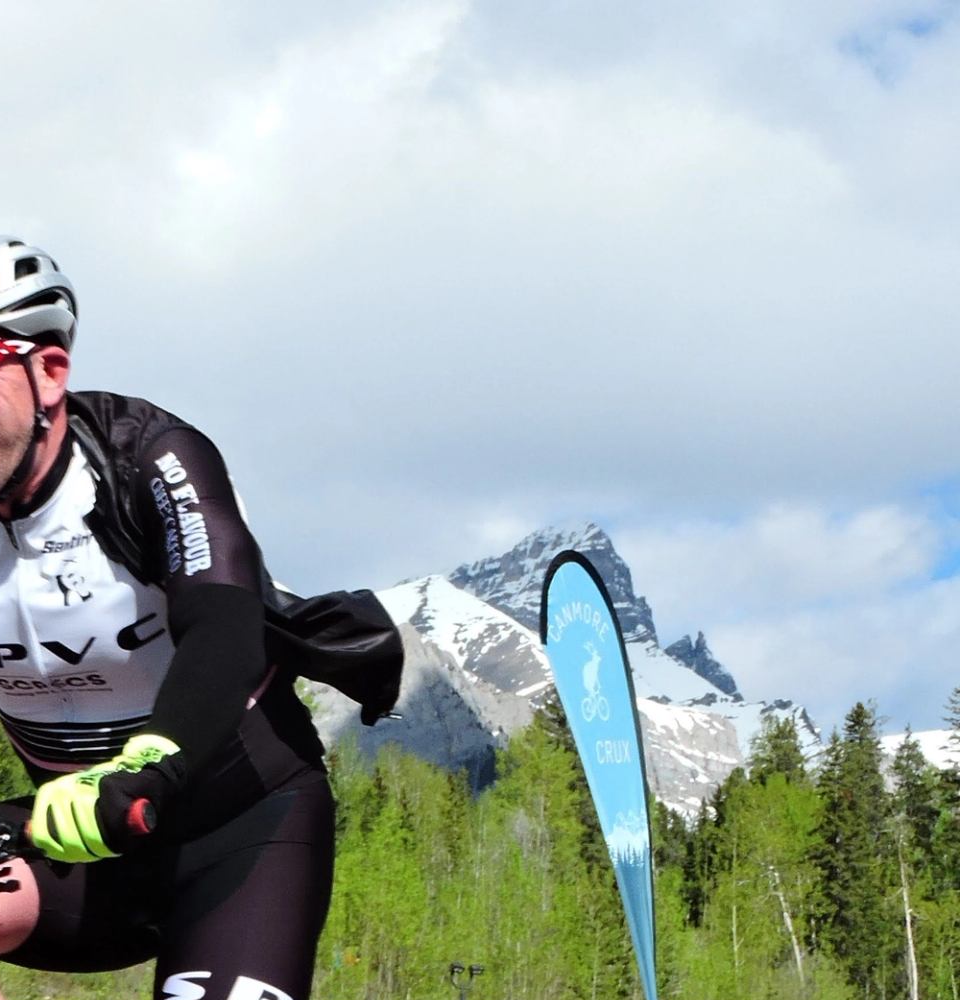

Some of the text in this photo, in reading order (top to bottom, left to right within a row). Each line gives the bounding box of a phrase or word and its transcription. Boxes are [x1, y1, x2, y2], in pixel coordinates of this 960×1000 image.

[154, 451, 187, 484] NO
[41, 533, 92, 553] Santin
[547, 602, 611, 643] CANMORE
[596, 740, 631, 765] CRUX
